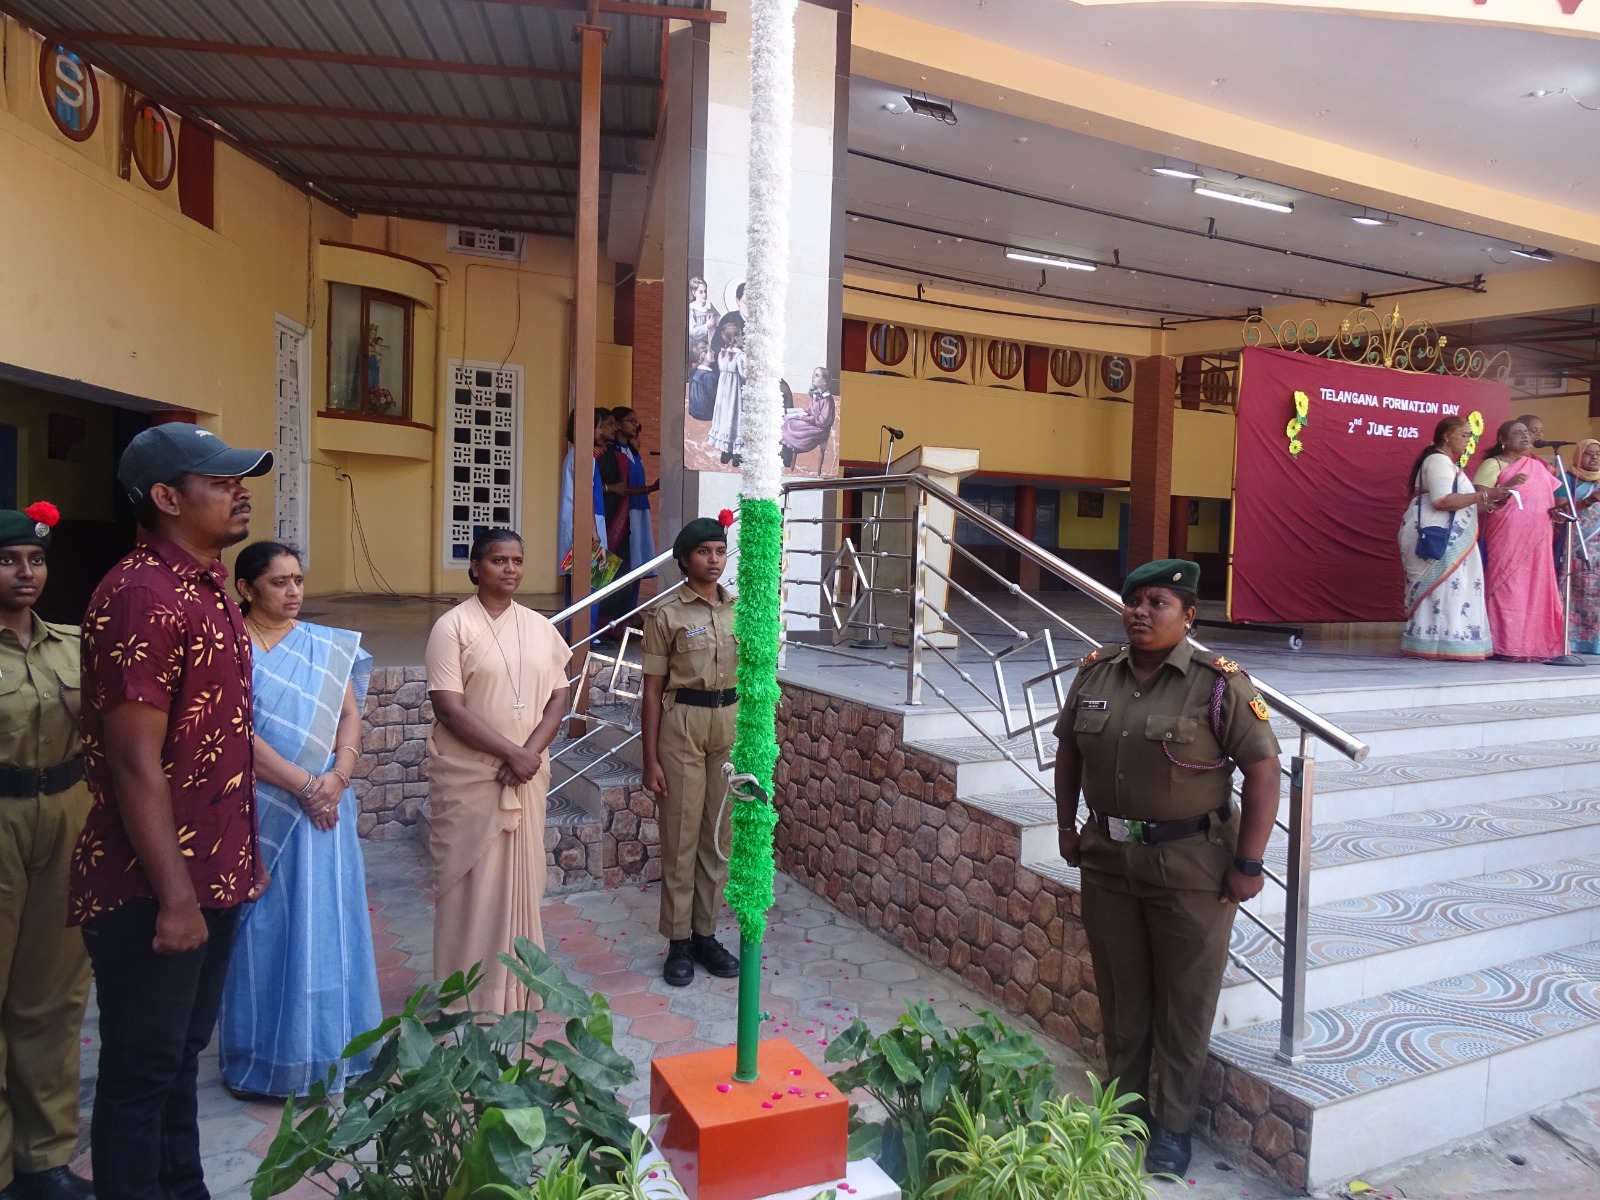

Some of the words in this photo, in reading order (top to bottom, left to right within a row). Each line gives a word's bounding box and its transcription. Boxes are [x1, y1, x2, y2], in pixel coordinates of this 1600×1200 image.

[56, 54, 84, 108] S
[939, 336, 958, 358] S
[1109, 359, 1124, 379] S
[1320, 387, 1379, 407] TELANGANA
[1383, 397, 1439, 414] FORMATION
[1442, 404, 1460, 416] DAY
[1348, 418, 1362, 433] 2nd
[1366, 422, 1393, 436] JUNE
[1397, 426, 1418, 438] 2025
